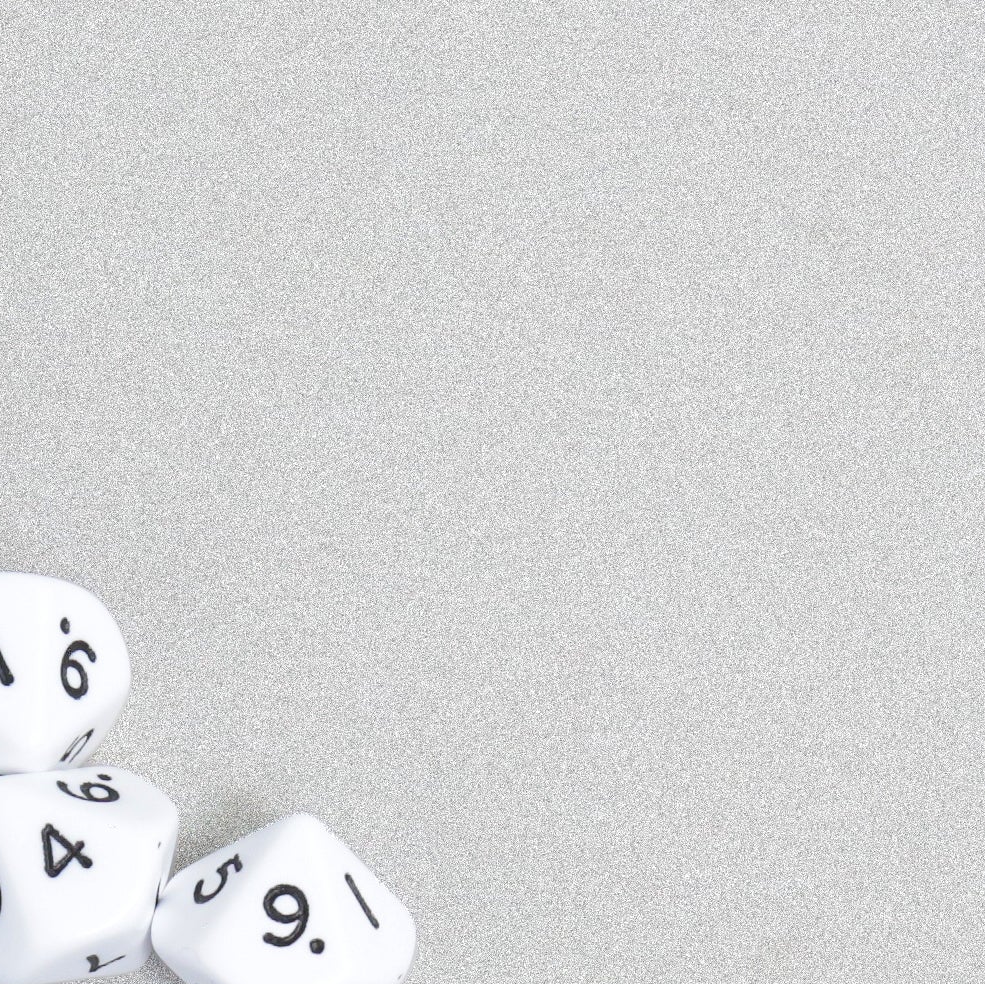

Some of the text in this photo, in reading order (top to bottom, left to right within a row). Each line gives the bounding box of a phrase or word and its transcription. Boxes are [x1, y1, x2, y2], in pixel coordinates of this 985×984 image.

[41, 823, 93, 878] 4
[193, 853, 243, 904] 5
[344, 872, 380, 929] 1
